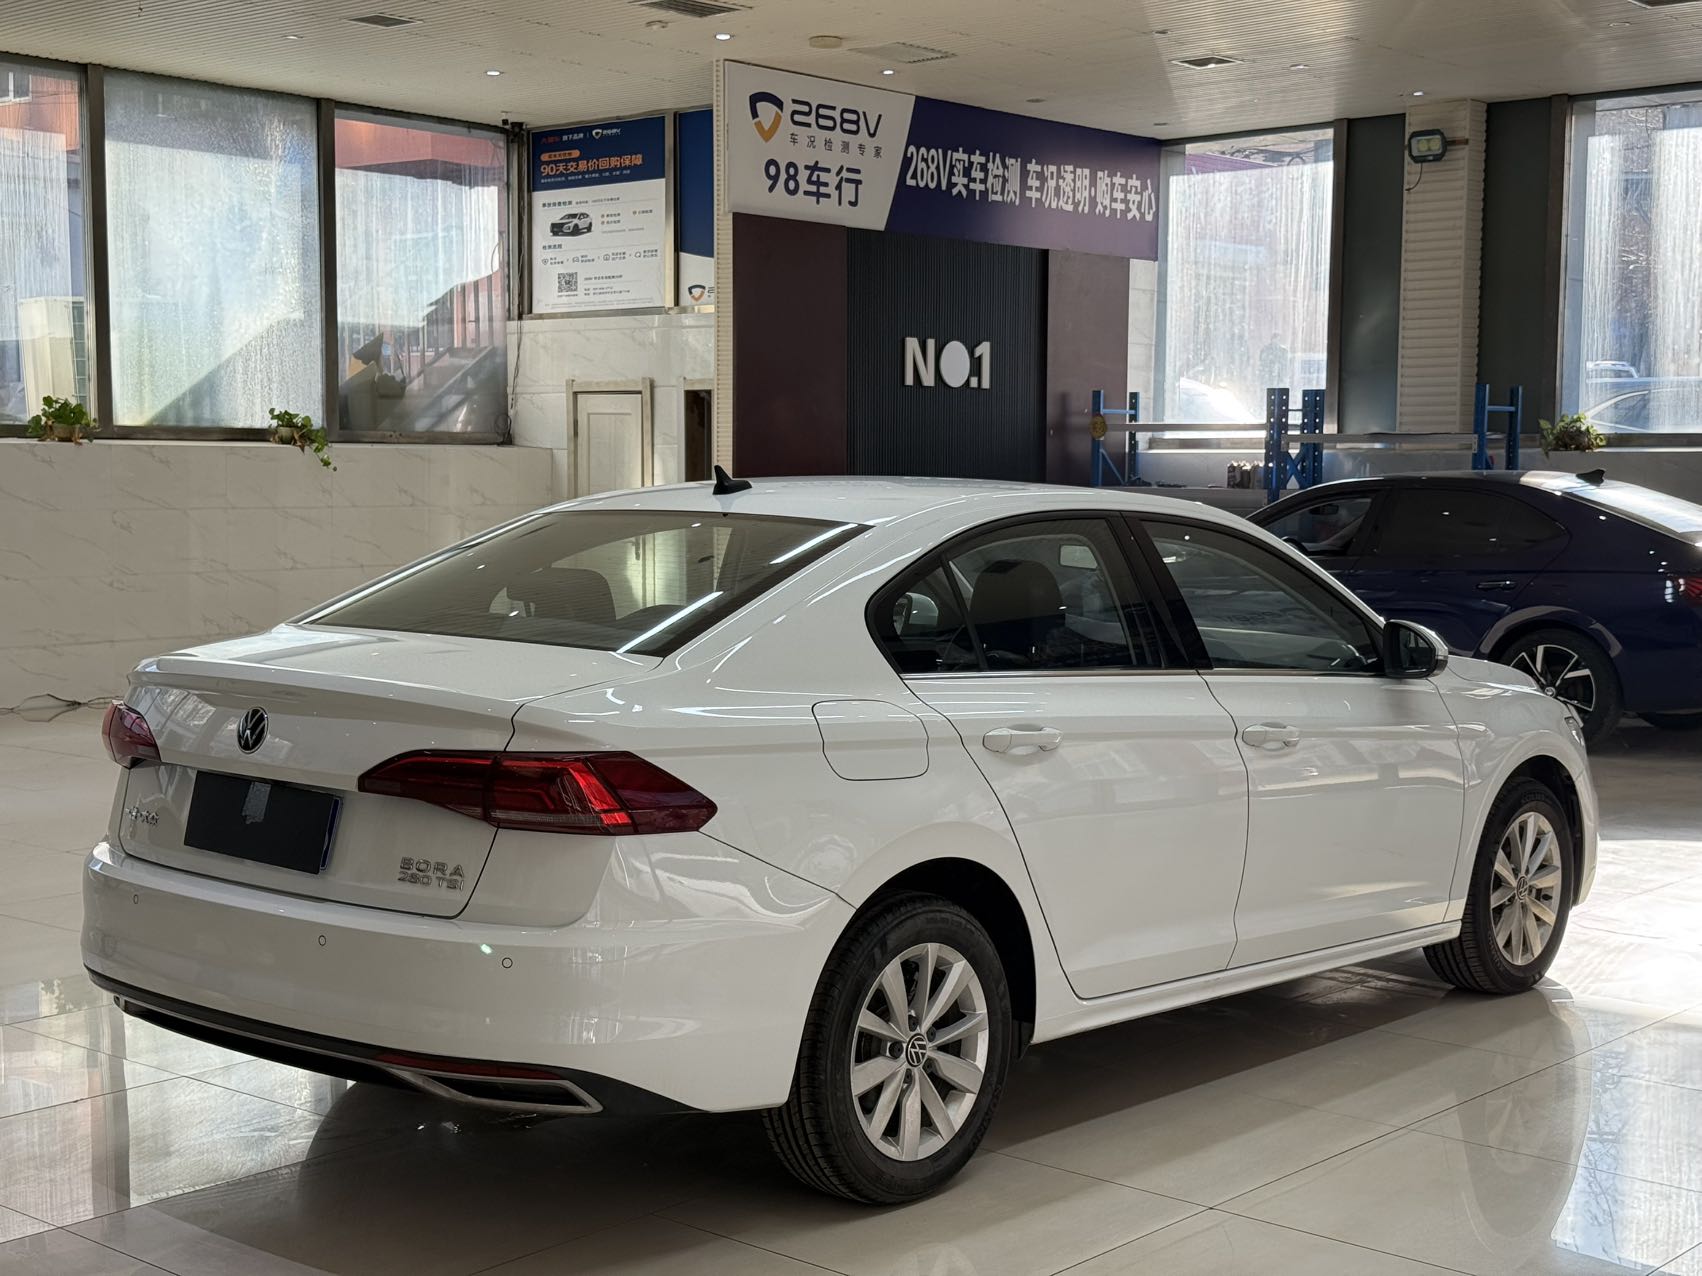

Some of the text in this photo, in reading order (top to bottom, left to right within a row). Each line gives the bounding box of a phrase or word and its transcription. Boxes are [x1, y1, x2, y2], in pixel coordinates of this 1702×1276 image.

[789, 98, 883, 139] 268V
[789, 132, 883, 160] 车况检测专家
[540, 153, 643, 177] 90天交易价回购保障
[764, 158, 864, 208] 98车行
[905, 144, 1157, 223] 268V实车检测 车况透明·购车安心
[903, 336, 991, 390] NO.1
[400, 856, 464, 878] BORA
[436, 876, 464, 892] TSI
